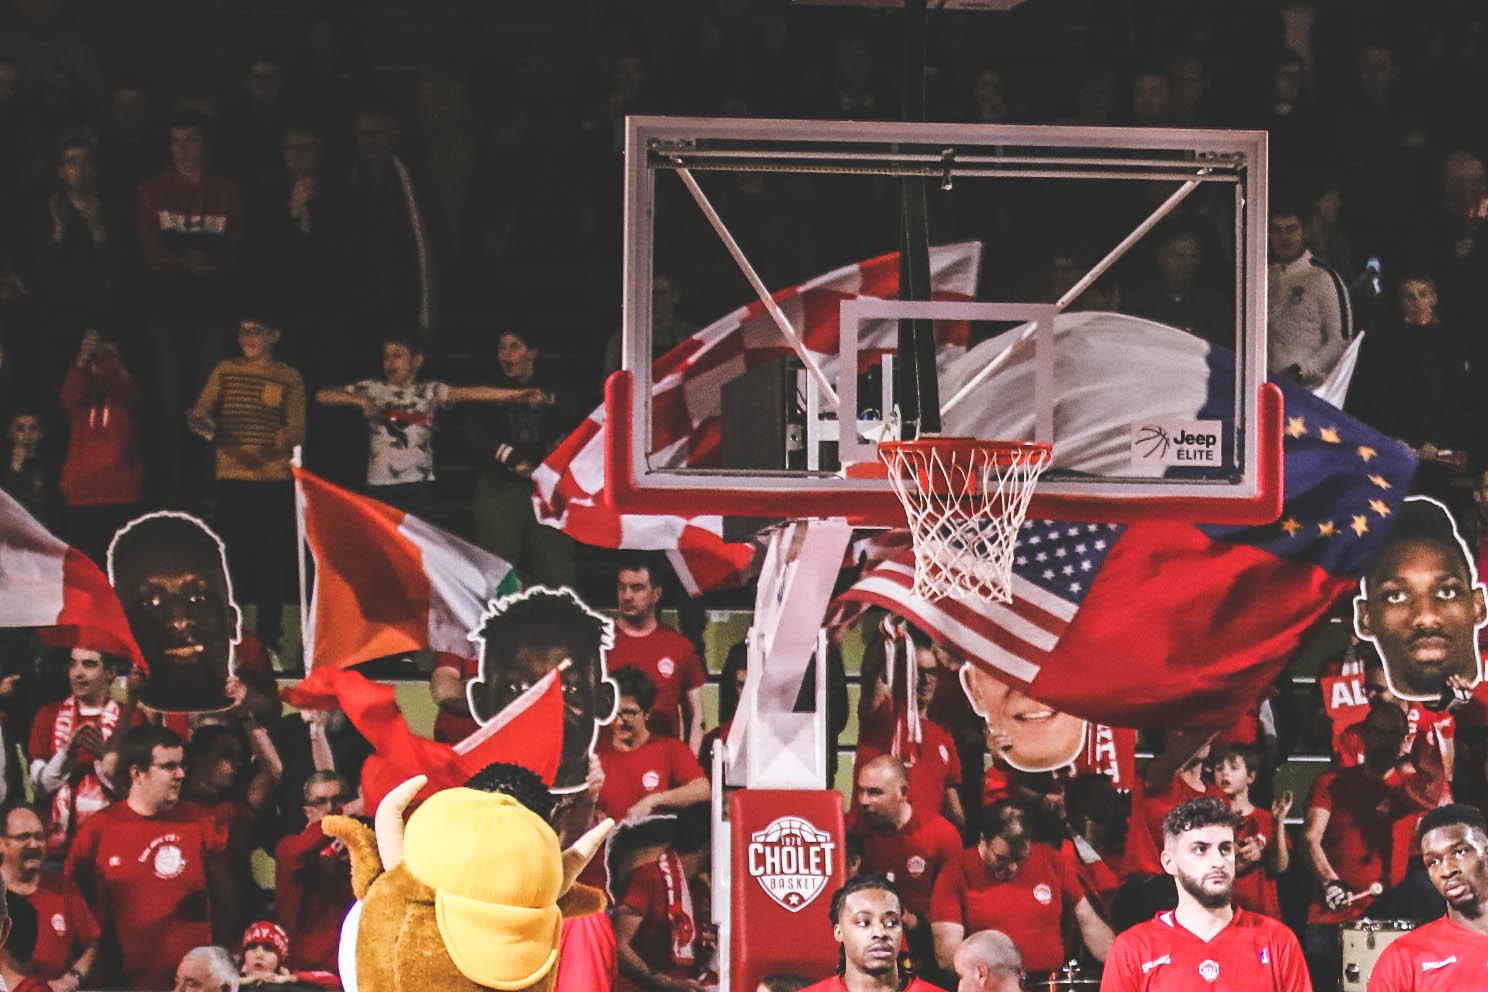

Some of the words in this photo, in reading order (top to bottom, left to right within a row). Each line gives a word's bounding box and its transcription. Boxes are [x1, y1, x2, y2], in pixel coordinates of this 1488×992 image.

[1174, 430, 1217, 448] Jeep
[748, 842, 835, 877] CHOLET
[770, 878, 816, 890] BASKET
